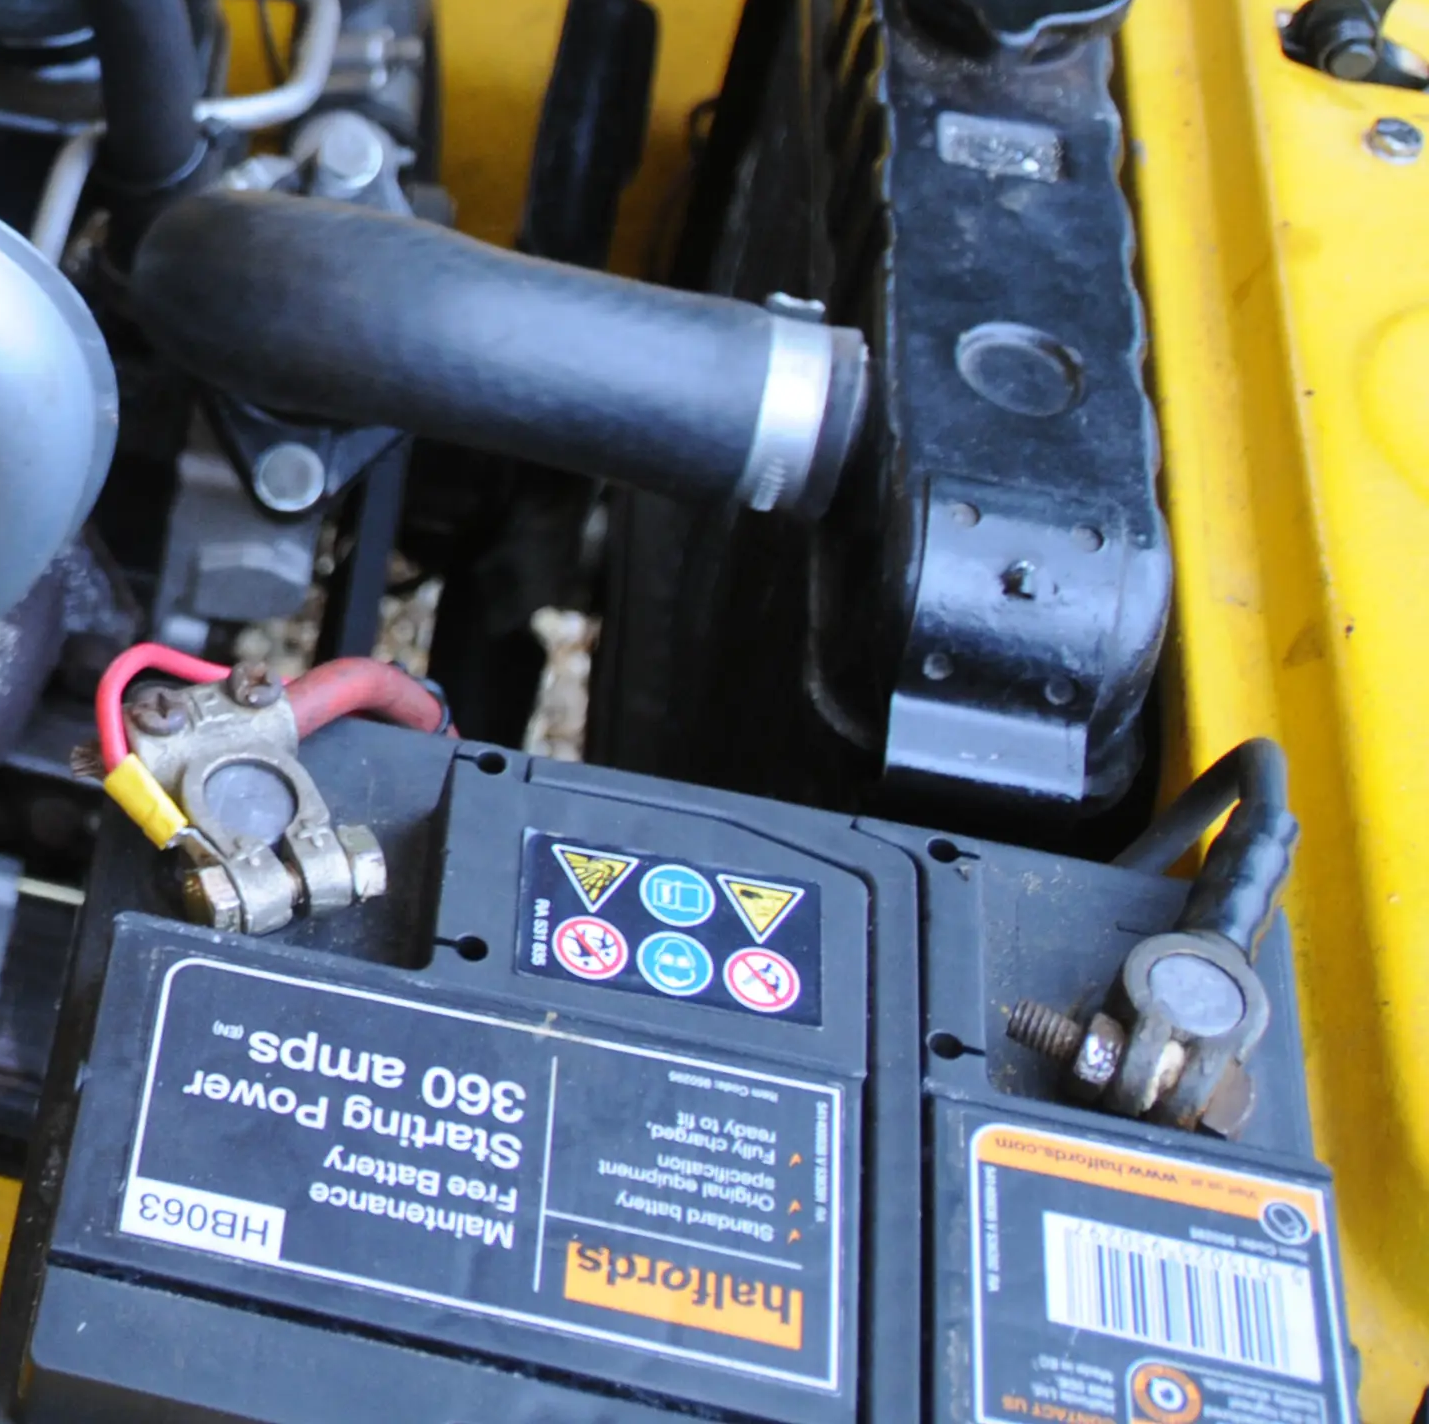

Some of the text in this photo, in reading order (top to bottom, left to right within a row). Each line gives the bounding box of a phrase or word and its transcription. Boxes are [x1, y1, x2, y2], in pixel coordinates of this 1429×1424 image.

[212, 1019, 526, 1123] 360 amps (EN)
[182, 1069, 522, 1169] Starting Power
[645, 1120, 775, 1165] Fully charged,
[675, 1109, 775, 1144] ready to fit
[322, 1144, 518, 1212] Free Battery
[597, 1158, 775, 1212] Original equipment
[655, 1153, 775, 1190] specification
[993, 1136, 1179, 1185] www.halfords.com
[139, 1193, 269, 1246] HB063
[308, 1181, 514, 1250] Maintenance
[614, 1189, 773, 1242] Standard battery
[576, 1244, 791, 1326] halfords
